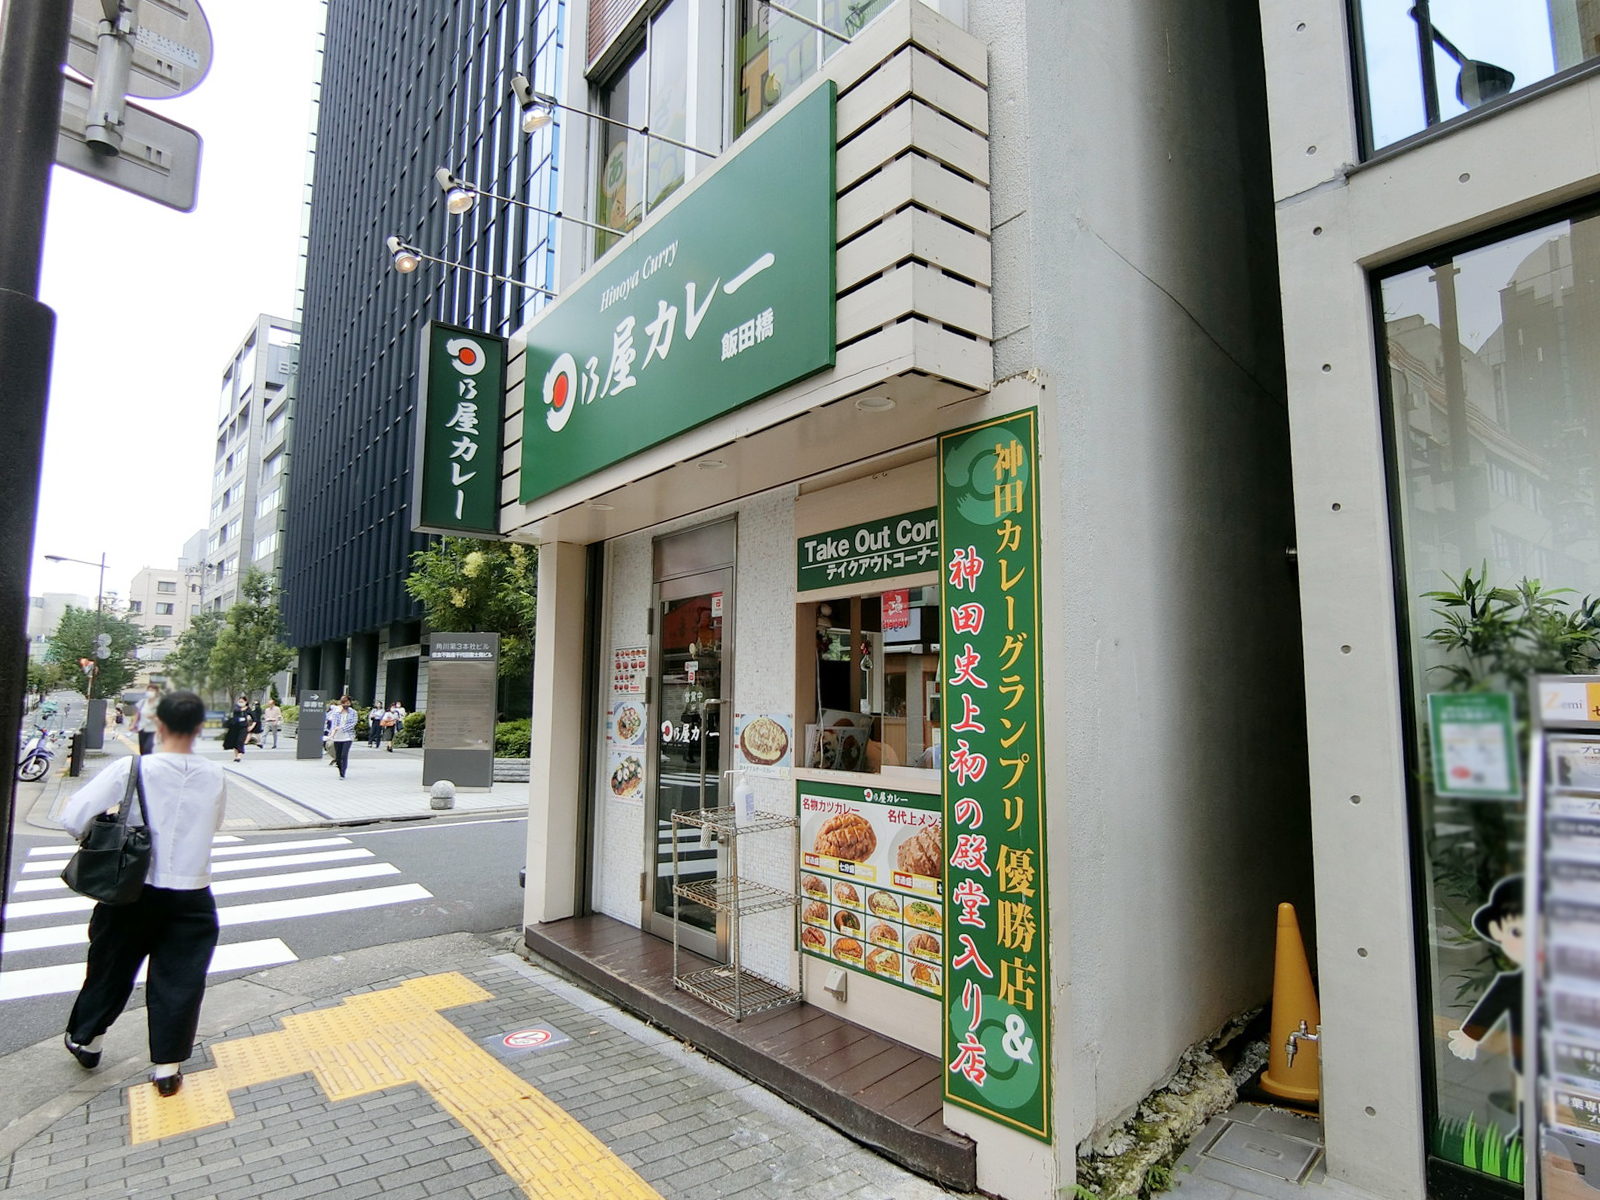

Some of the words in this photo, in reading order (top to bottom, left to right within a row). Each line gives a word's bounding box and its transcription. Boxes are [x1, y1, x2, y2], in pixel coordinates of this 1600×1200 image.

[600, 269, 639, 313] Hinoya
[642, 239, 678, 280] Curry
[721, 308, 774, 361] 飯田橋
[804, 537, 850, 563] Take
[854, 525, 891, 553] Out
[803, 797, 860, 815] 名物カツカレー
[887, 809, 942, 828] 名代上メン
[949, 545, 993, 1087] 神田史上初の殿堂入り店
